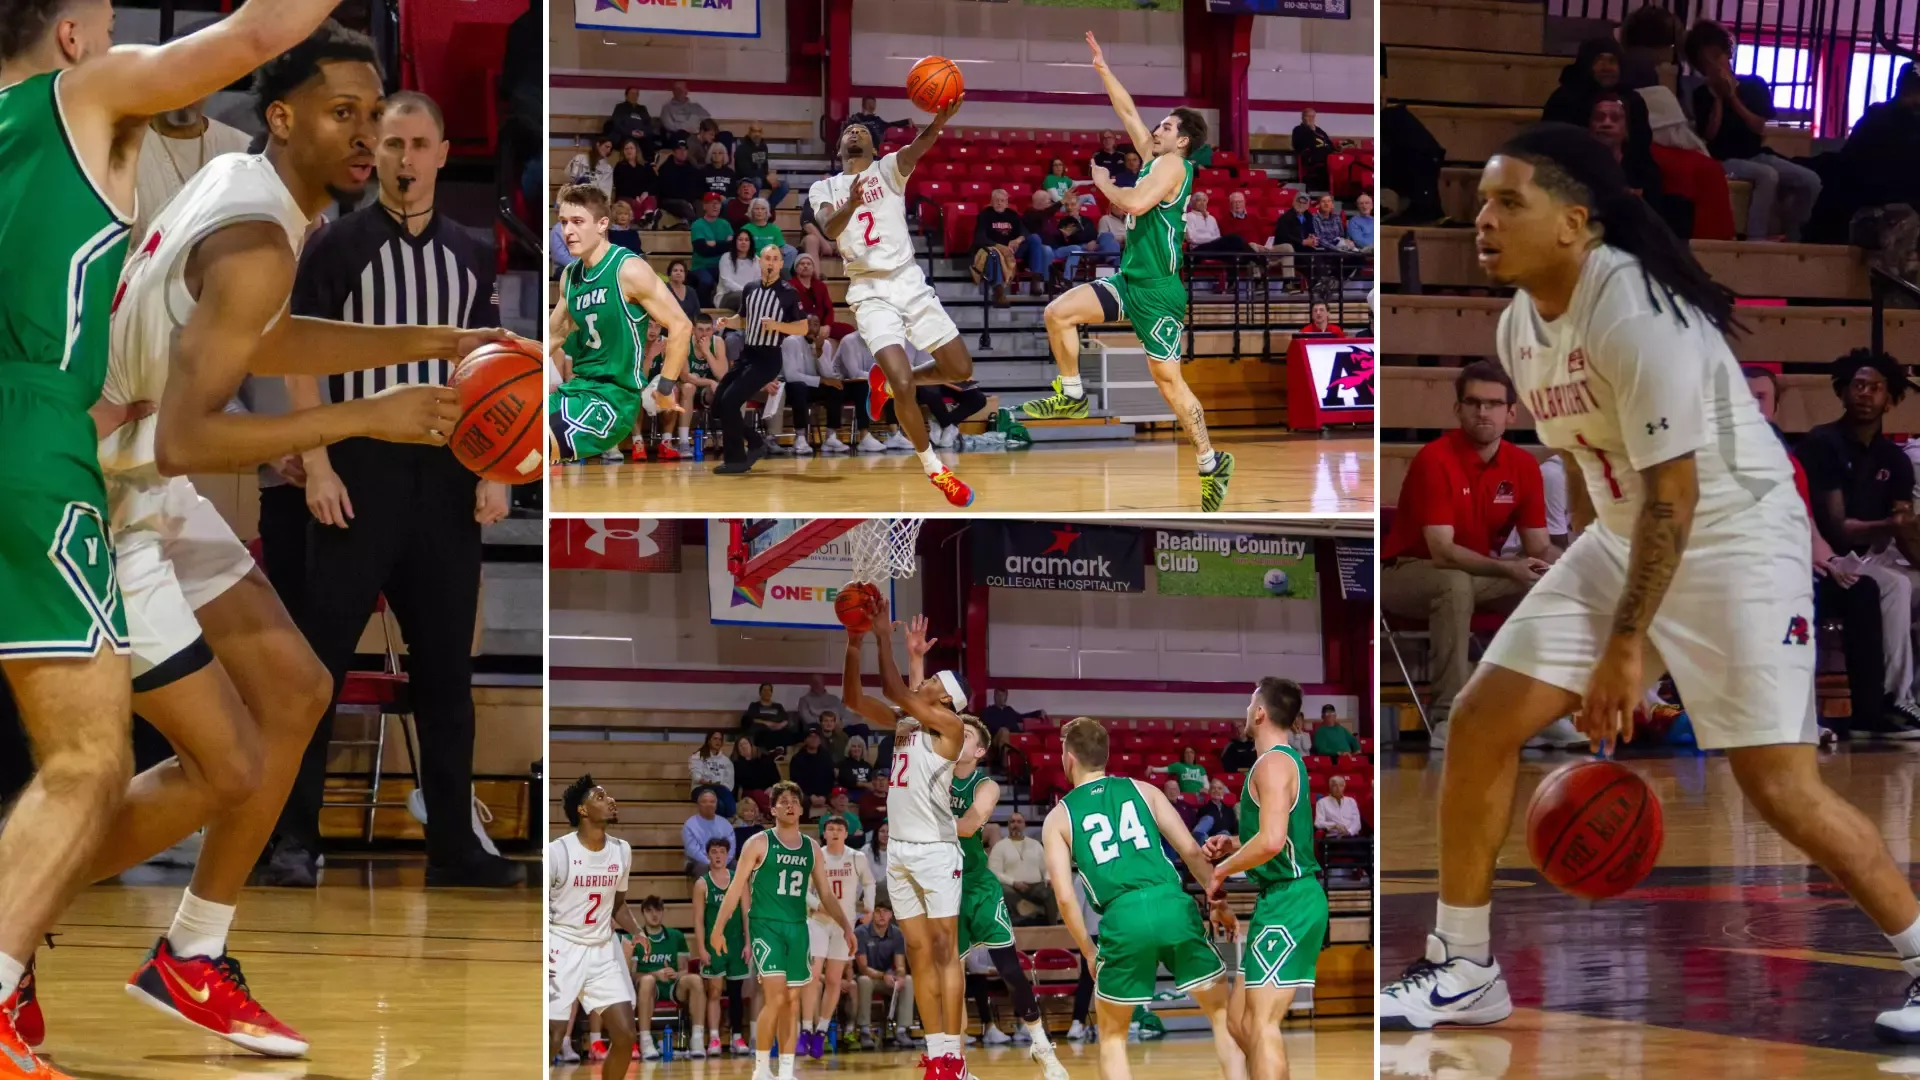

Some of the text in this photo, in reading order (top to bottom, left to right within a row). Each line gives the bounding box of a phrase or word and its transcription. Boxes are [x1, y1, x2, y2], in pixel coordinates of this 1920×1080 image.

[857, 211, 881, 246] 2
[575, 288, 608, 311] YORK
[585, 313, 602, 350] 5
[482, 391, 526, 437] THE
[83, 536, 98, 566] Y
[1156, 531, 1306, 560] Reading Country
[1005, 555, 1112, 577] aramark
[1156, 552, 1199, 573] Club
[770, 585, 838, 602] ONETE
[986, 575, 1131, 592] COLLEGIATE HOSPITALITY
[1082, 799, 1151, 865] 24
[776, 853, 808, 867] YORK
[573, 874, 619, 887] ALBRIGHT
[776, 868, 804, 897] 12
[832, 880, 842, 900] 0
[584, 893, 602, 925] 2
[1267, 939, 1278, 952] Y
